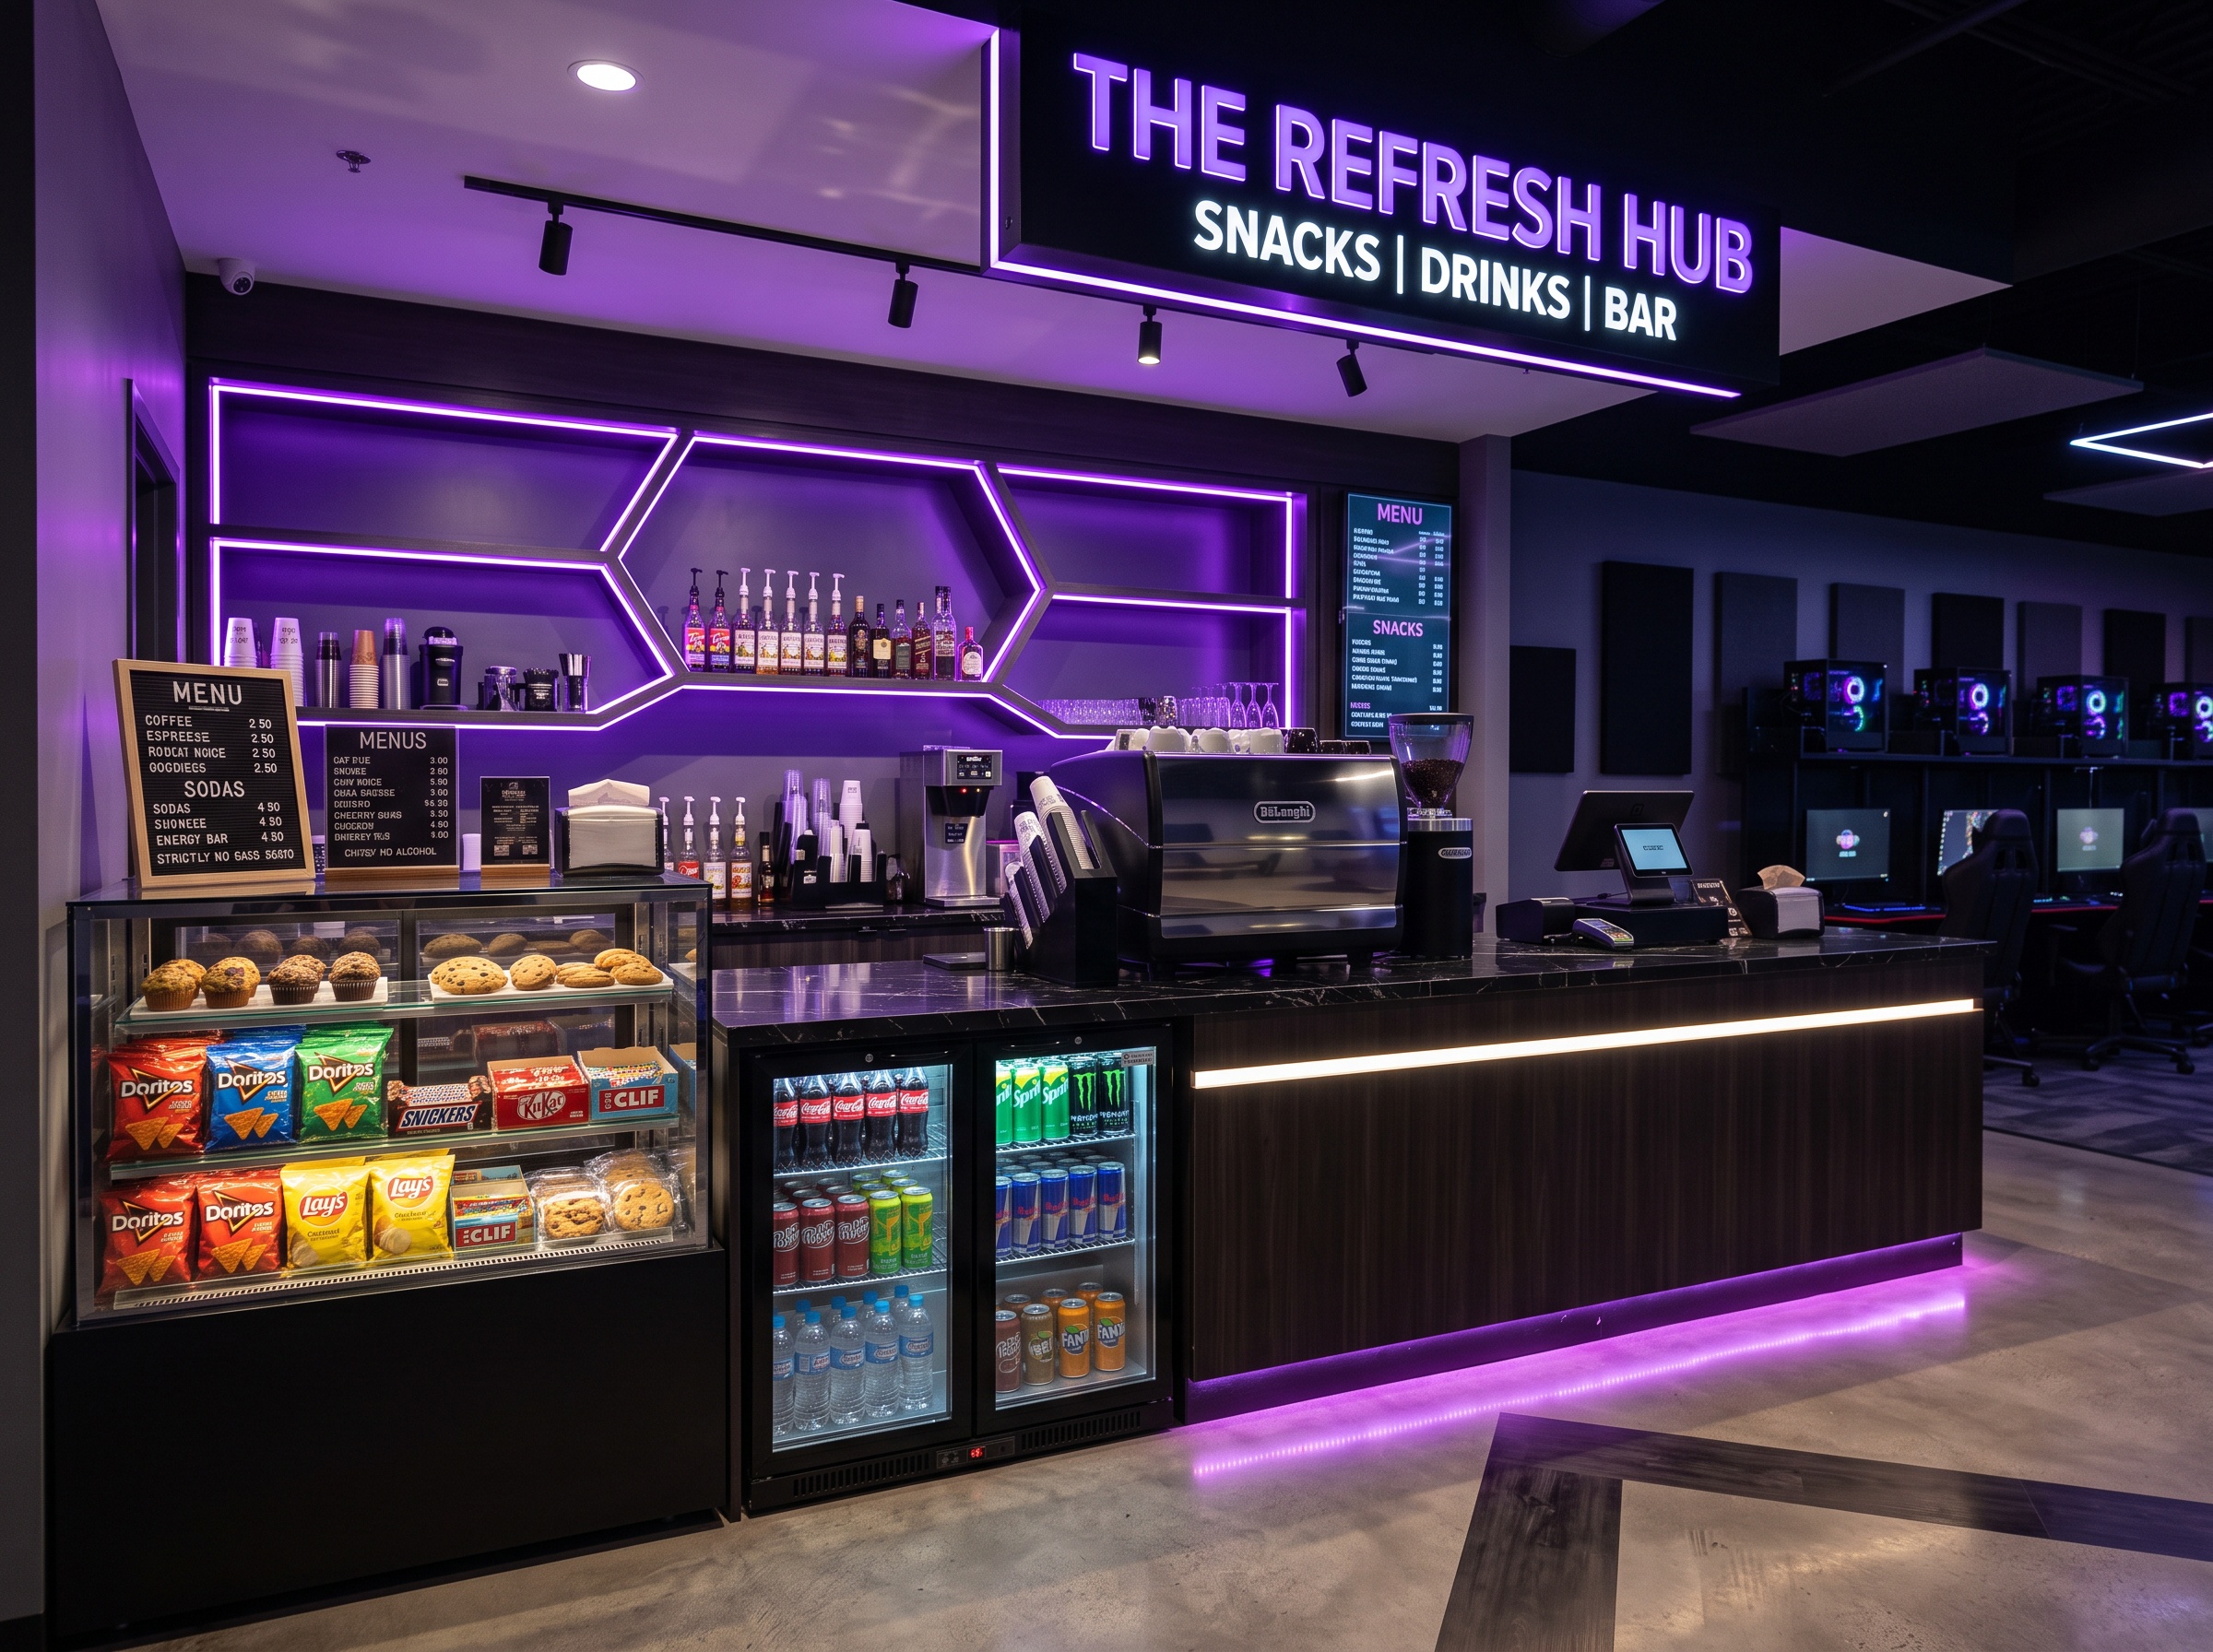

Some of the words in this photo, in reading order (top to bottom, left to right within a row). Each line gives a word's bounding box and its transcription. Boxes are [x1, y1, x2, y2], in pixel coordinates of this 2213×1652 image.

[1073, 53, 1246, 182] THE
[1275, 104, 1601, 262] REFRESH
[1625, 194, 1753, 294] HUB
[1194, 200, 1380, 281] SNACKS
[1421, 247, 1571, 320] DRINKS
[1604, 287, 1676, 342] BAR
[1378, 503, 1423, 525] MENU
[1373, 620, 1424, 637] SNACKS
[173, 681, 242, 704] MENU
[146, 715, 192, 726] COFFEE
[361, 732, 426, 749] MENUS
[254, 763, 277, 773] 2.50
[184, 781, 244, 797] SODAS
[154, 804, 190, 814] SODAS
[157, 834, 200, 845] ENERGY
[207, 833, 228, 844] BAR
[158, 853, 209, 864] STRICTLY
[215, 852, 229, 861] NO
[396, 847, 436, 856] ALCOHOL
[219, 1069, 286, 1089] Doritos
[309, 1062, 373, 1081] Doritos
[121, 1080, 193, 1097] Doritos
[613, 1089, 659, 1108] CLIF
[400, 1104, 476, 1127] SNICKERS
[391, 1177, 432, 1199] Lay's
[206, 1200, 274, 1221] Doritos
[302, 1194, 345, 1216] Lay's
[112, 1210, 183, 1232] Doritos
[470, 1224, 511, 1243] CLIF
